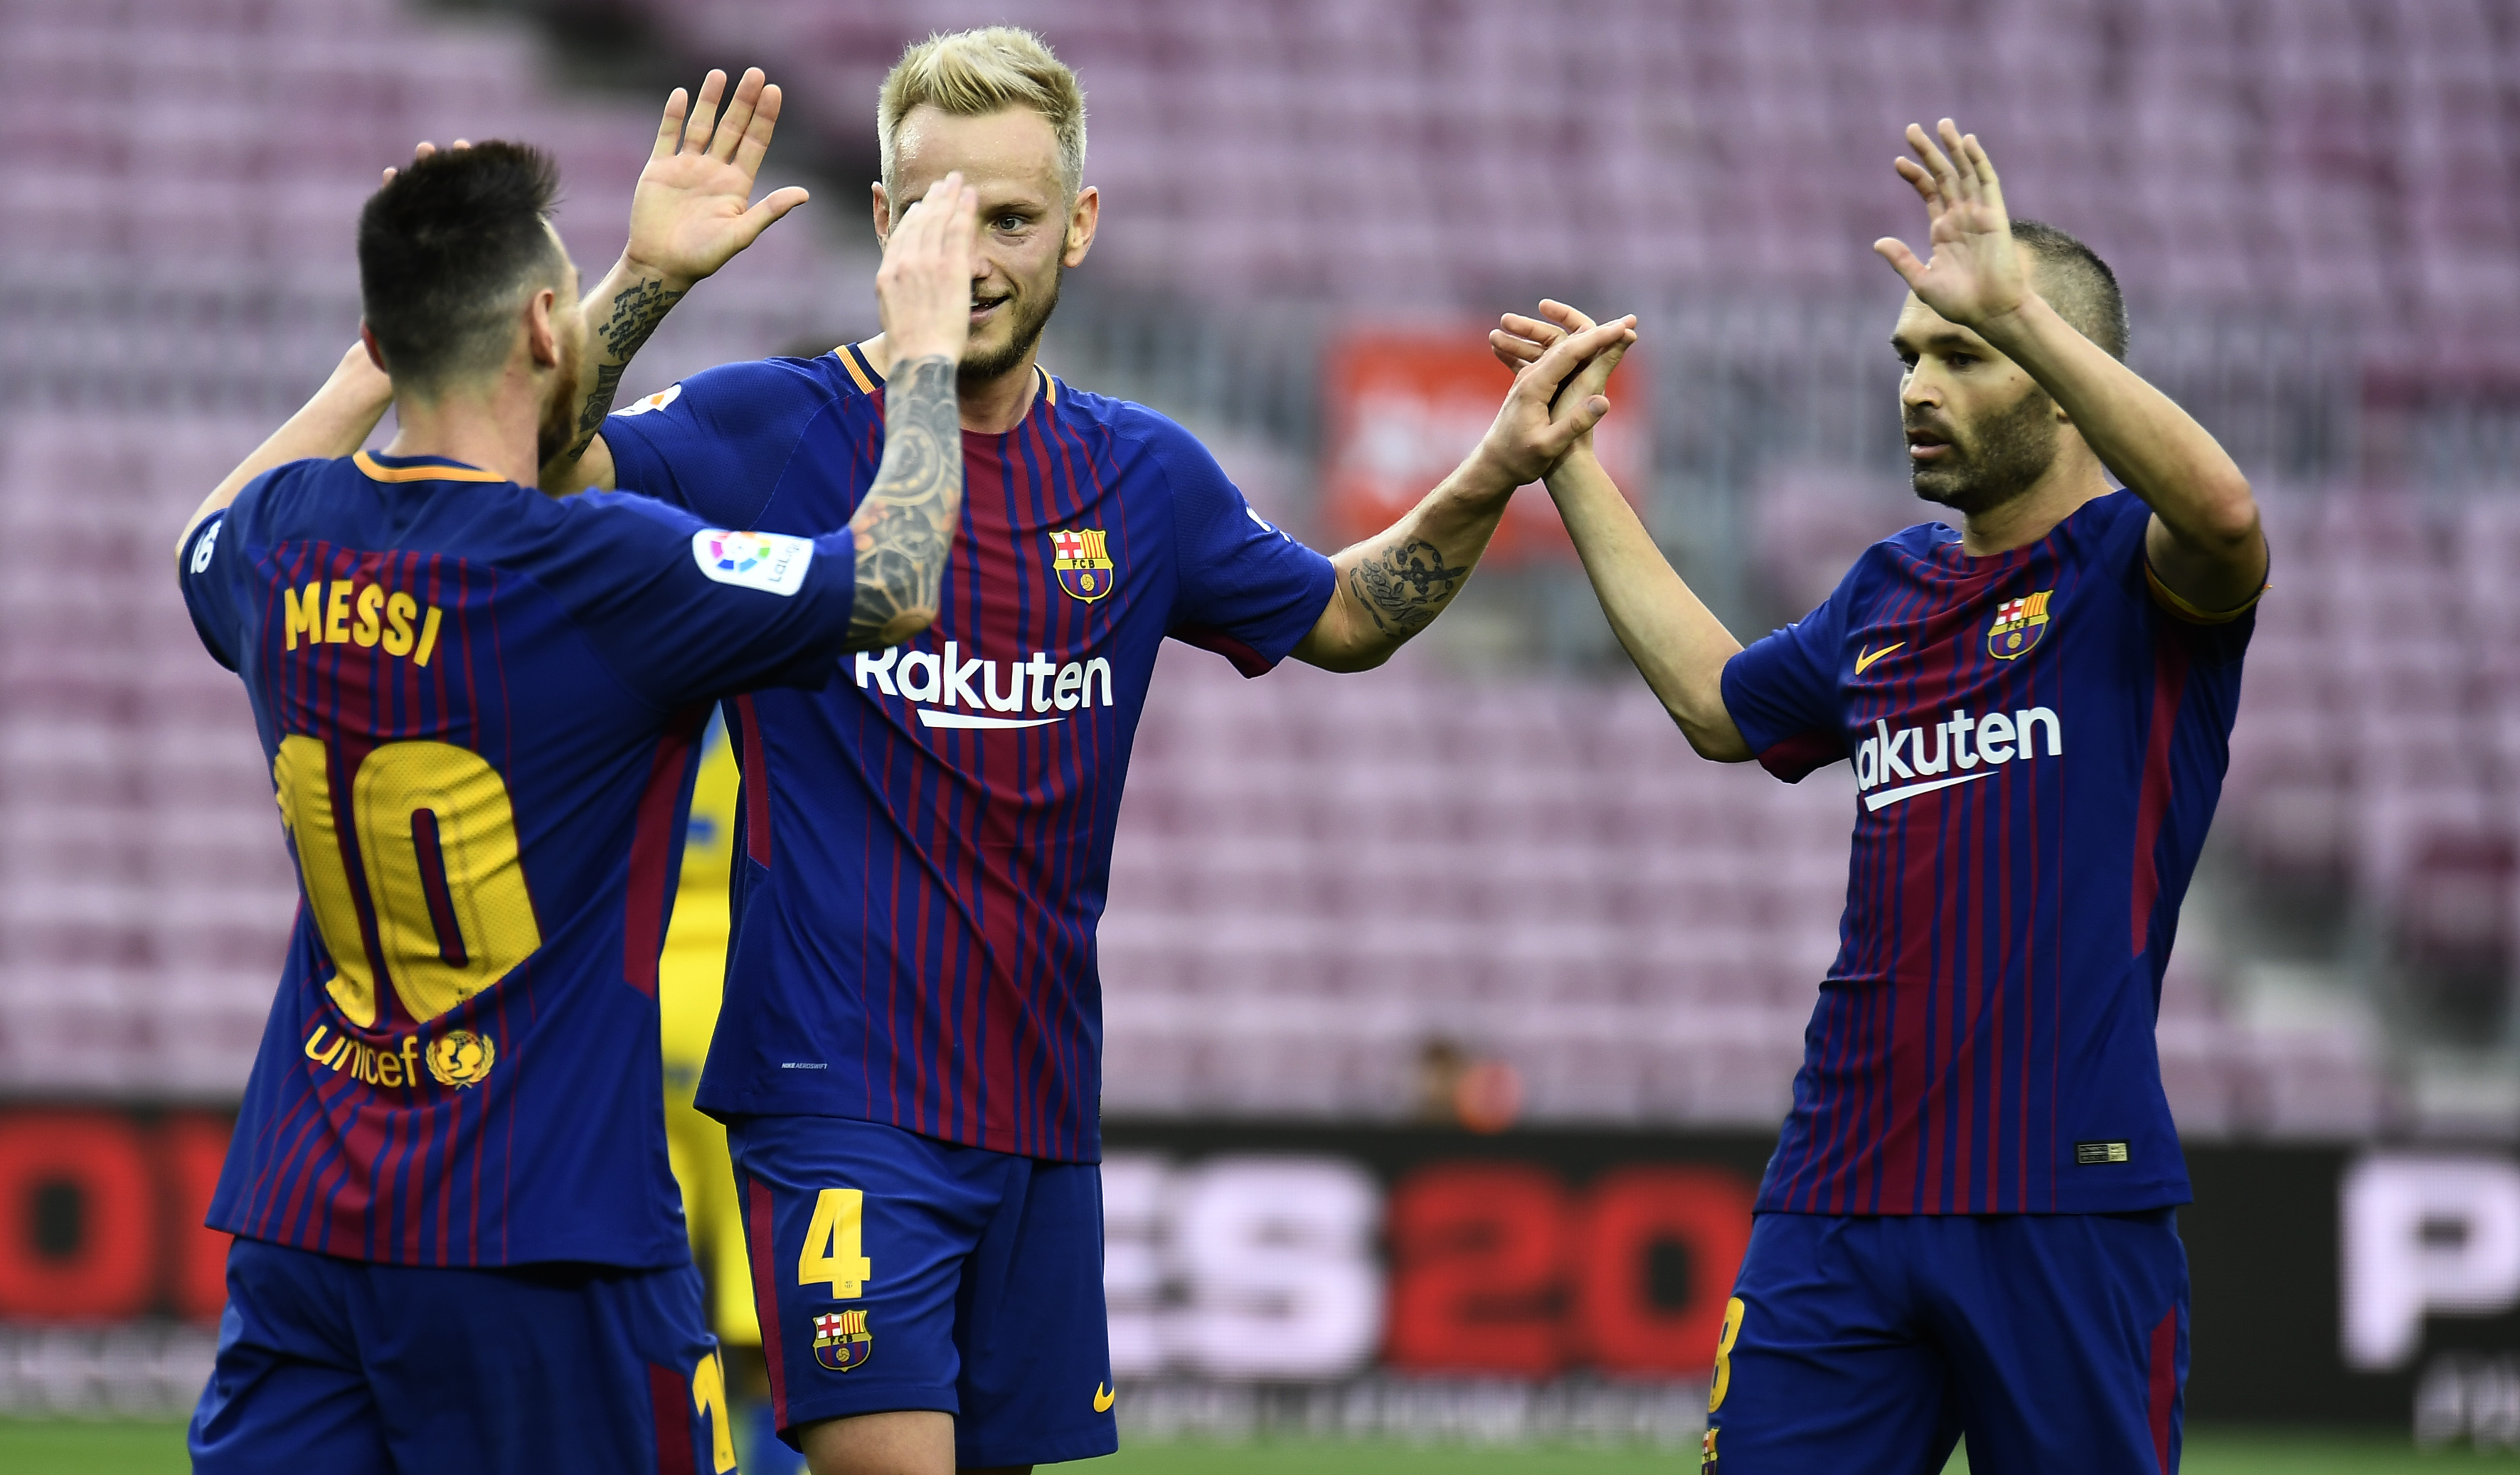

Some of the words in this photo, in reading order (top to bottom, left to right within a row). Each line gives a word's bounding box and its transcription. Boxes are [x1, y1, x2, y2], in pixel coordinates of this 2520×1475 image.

[285, 580, 442, 667] MESSI
[856, 641, 1113, 713] Rakuten
[1856, 707, 2062, 791] akuten
[275, 733, 541, 1028] 10
[305, 1025, 418, 1088] unicef
[798, 1188, 871, 1299] 4
